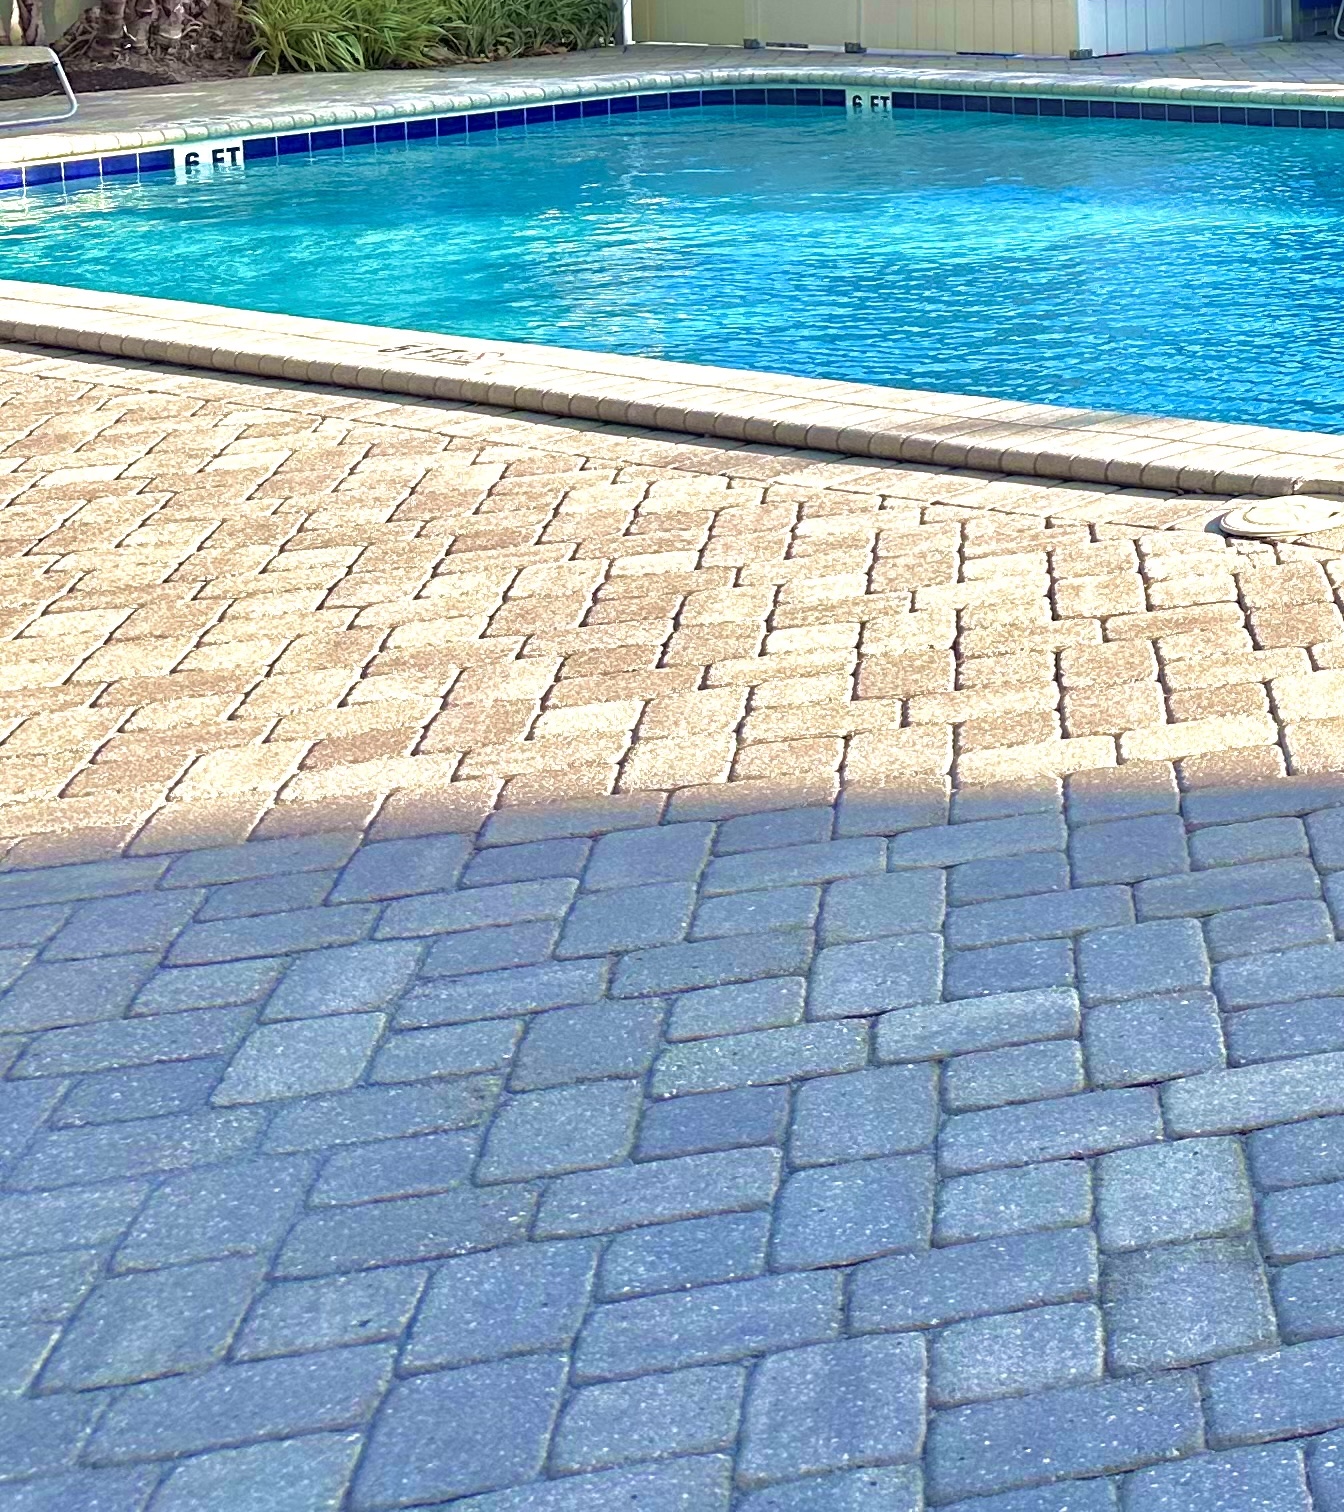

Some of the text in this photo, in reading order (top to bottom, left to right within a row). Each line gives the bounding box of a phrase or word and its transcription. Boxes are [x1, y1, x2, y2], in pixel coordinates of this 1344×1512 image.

[853, 95, 890, 112] 6 FT
[185, 147, 240, 175] 6 FT
